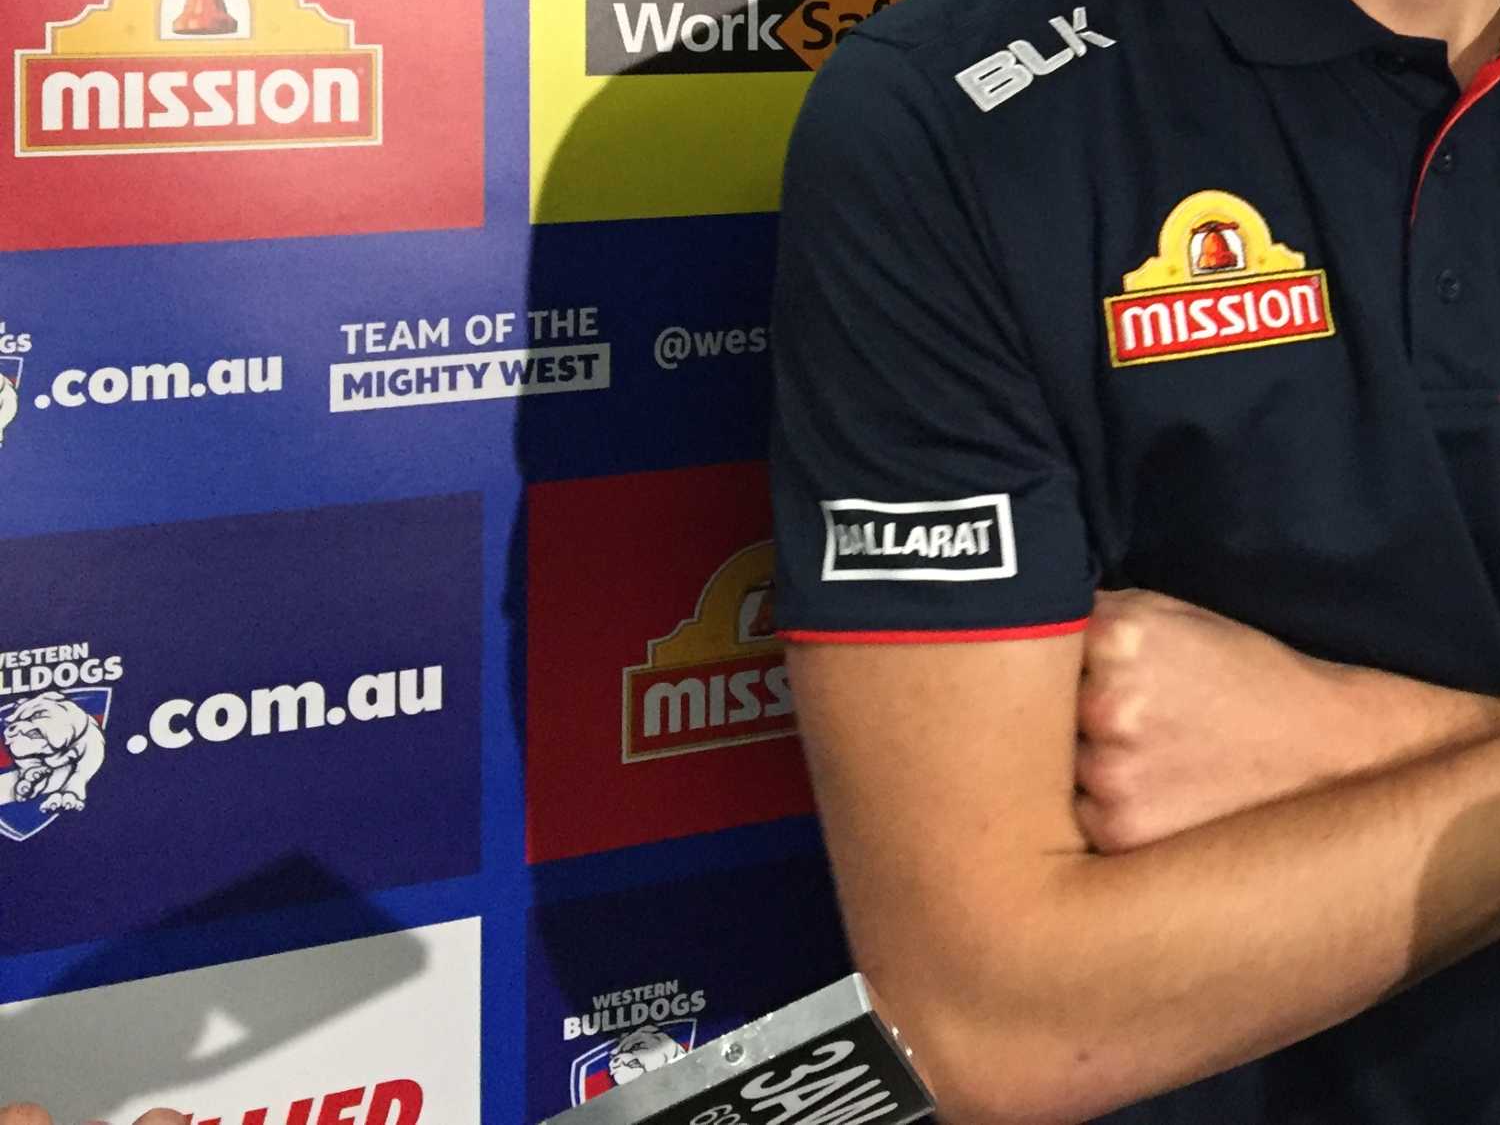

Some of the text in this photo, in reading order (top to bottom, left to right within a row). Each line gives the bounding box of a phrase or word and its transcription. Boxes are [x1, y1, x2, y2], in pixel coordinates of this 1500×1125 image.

[955, 6, 1117, 113] BLK
[341, 307, 599, 355] TEAM OF THE
[34, 356, 283, 410] .com.au
[342, 353, 600, 401] MIGHTY WEST
[0, 656, 123, 695] LLDOGS
[126, 665, 443, 755] .com.au
[563, 989, 707, 1041] BULLDOGS
[592, 979, 679, 1012] WESTERN
